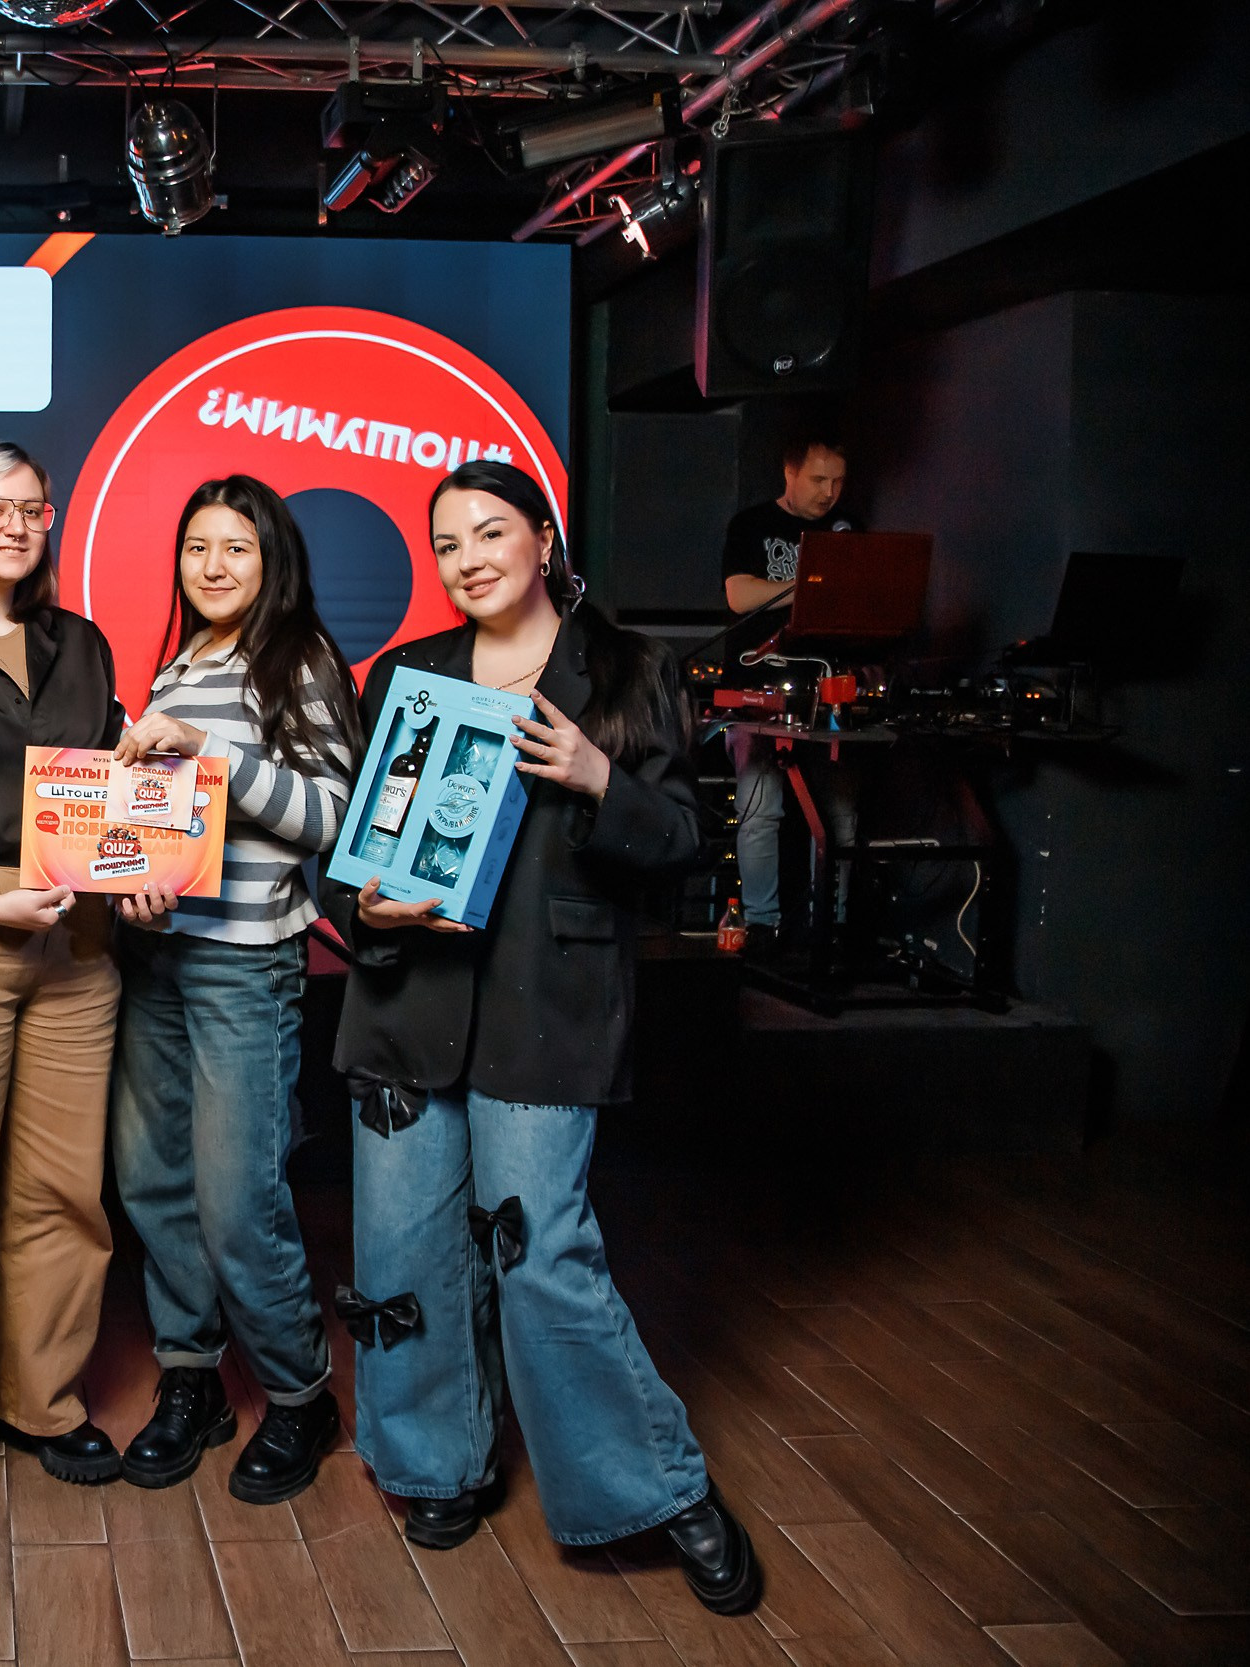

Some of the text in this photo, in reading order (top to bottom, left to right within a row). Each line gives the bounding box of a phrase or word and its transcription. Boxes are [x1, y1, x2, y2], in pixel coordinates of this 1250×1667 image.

[776, 360, 792, 370] RCF
[413, 690, 430, 715] 8
[30, 765, 101, 780] ЛАУРЕАТЫ
[139, 789, 162, 799] QUIZ
[434, 805, 480, 829] ОТКРЫВАЙ НОВОЕ
[103, 842, 135, 856] QUIZ
